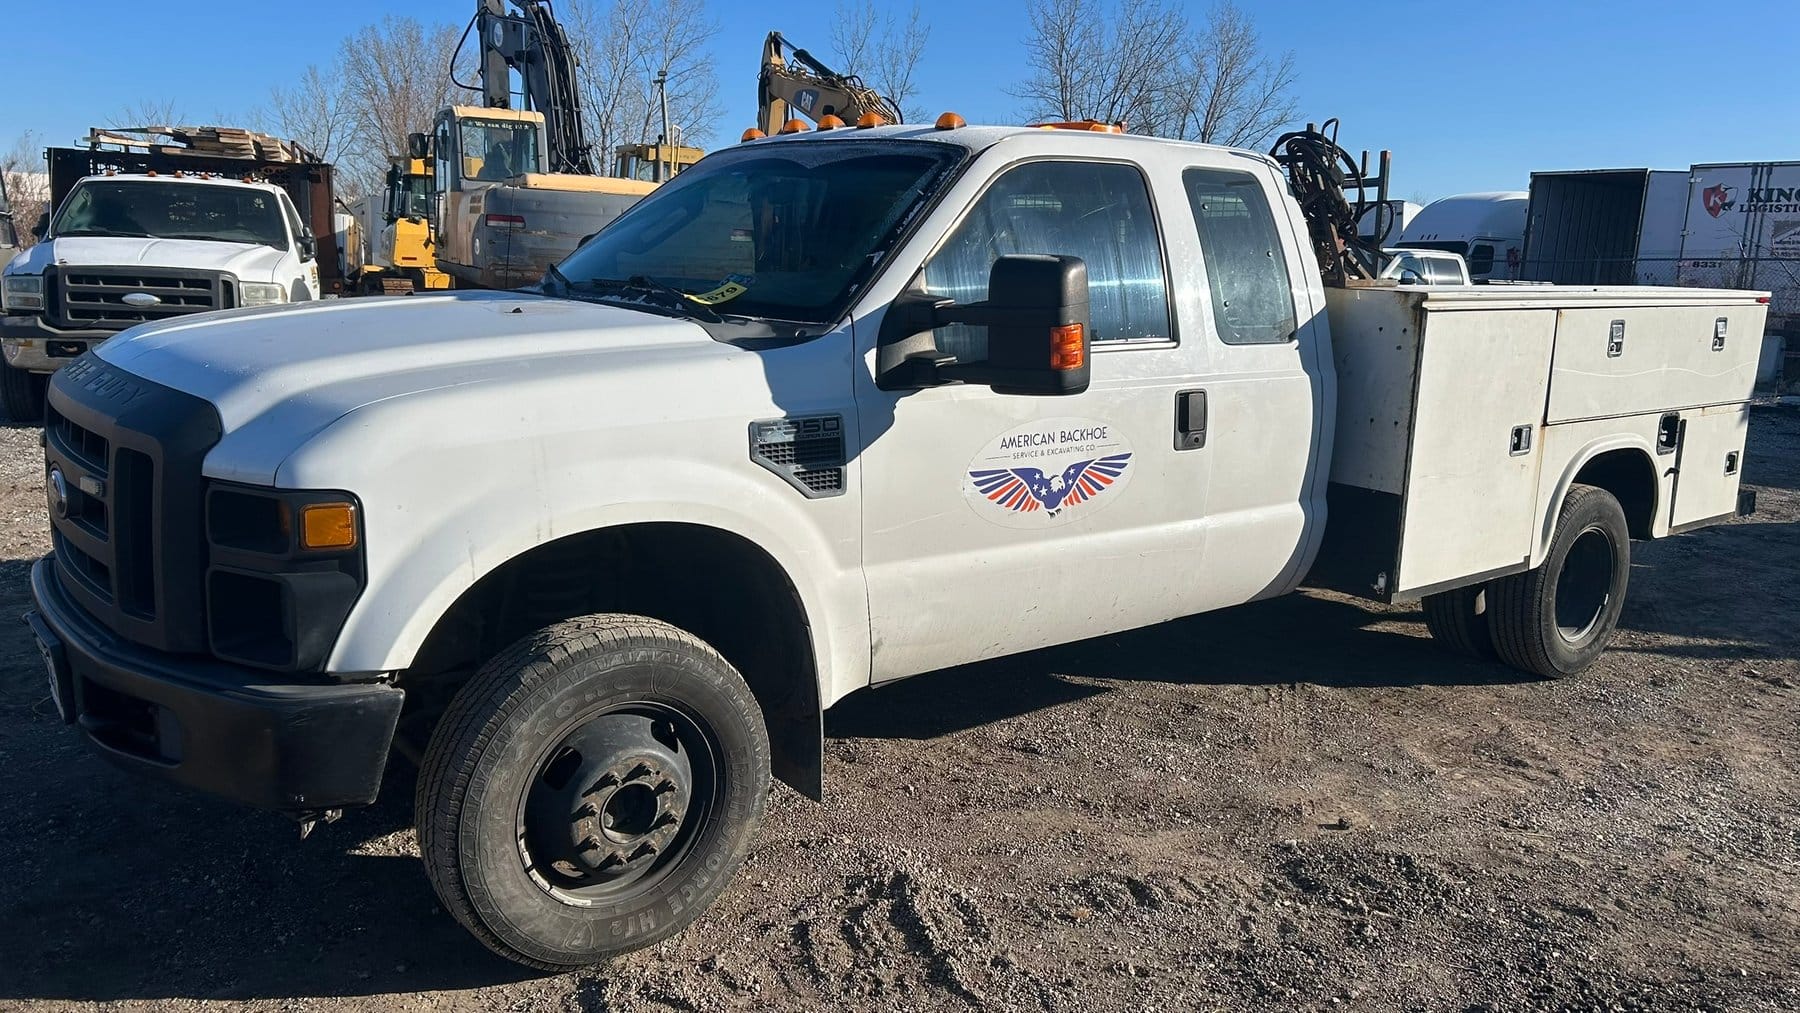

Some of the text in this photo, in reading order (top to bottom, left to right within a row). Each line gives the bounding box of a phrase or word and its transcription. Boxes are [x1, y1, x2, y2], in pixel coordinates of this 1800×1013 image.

[800, 91, 814, 113] CAT
[1000, 426, 1107, 450] AMERICAN BACKHOE
[1012, 449, 1038, 460] SERVICE
[1040, 449, 1045, 457] &
[1046, 445, 1084, 456] EXCAVATING
